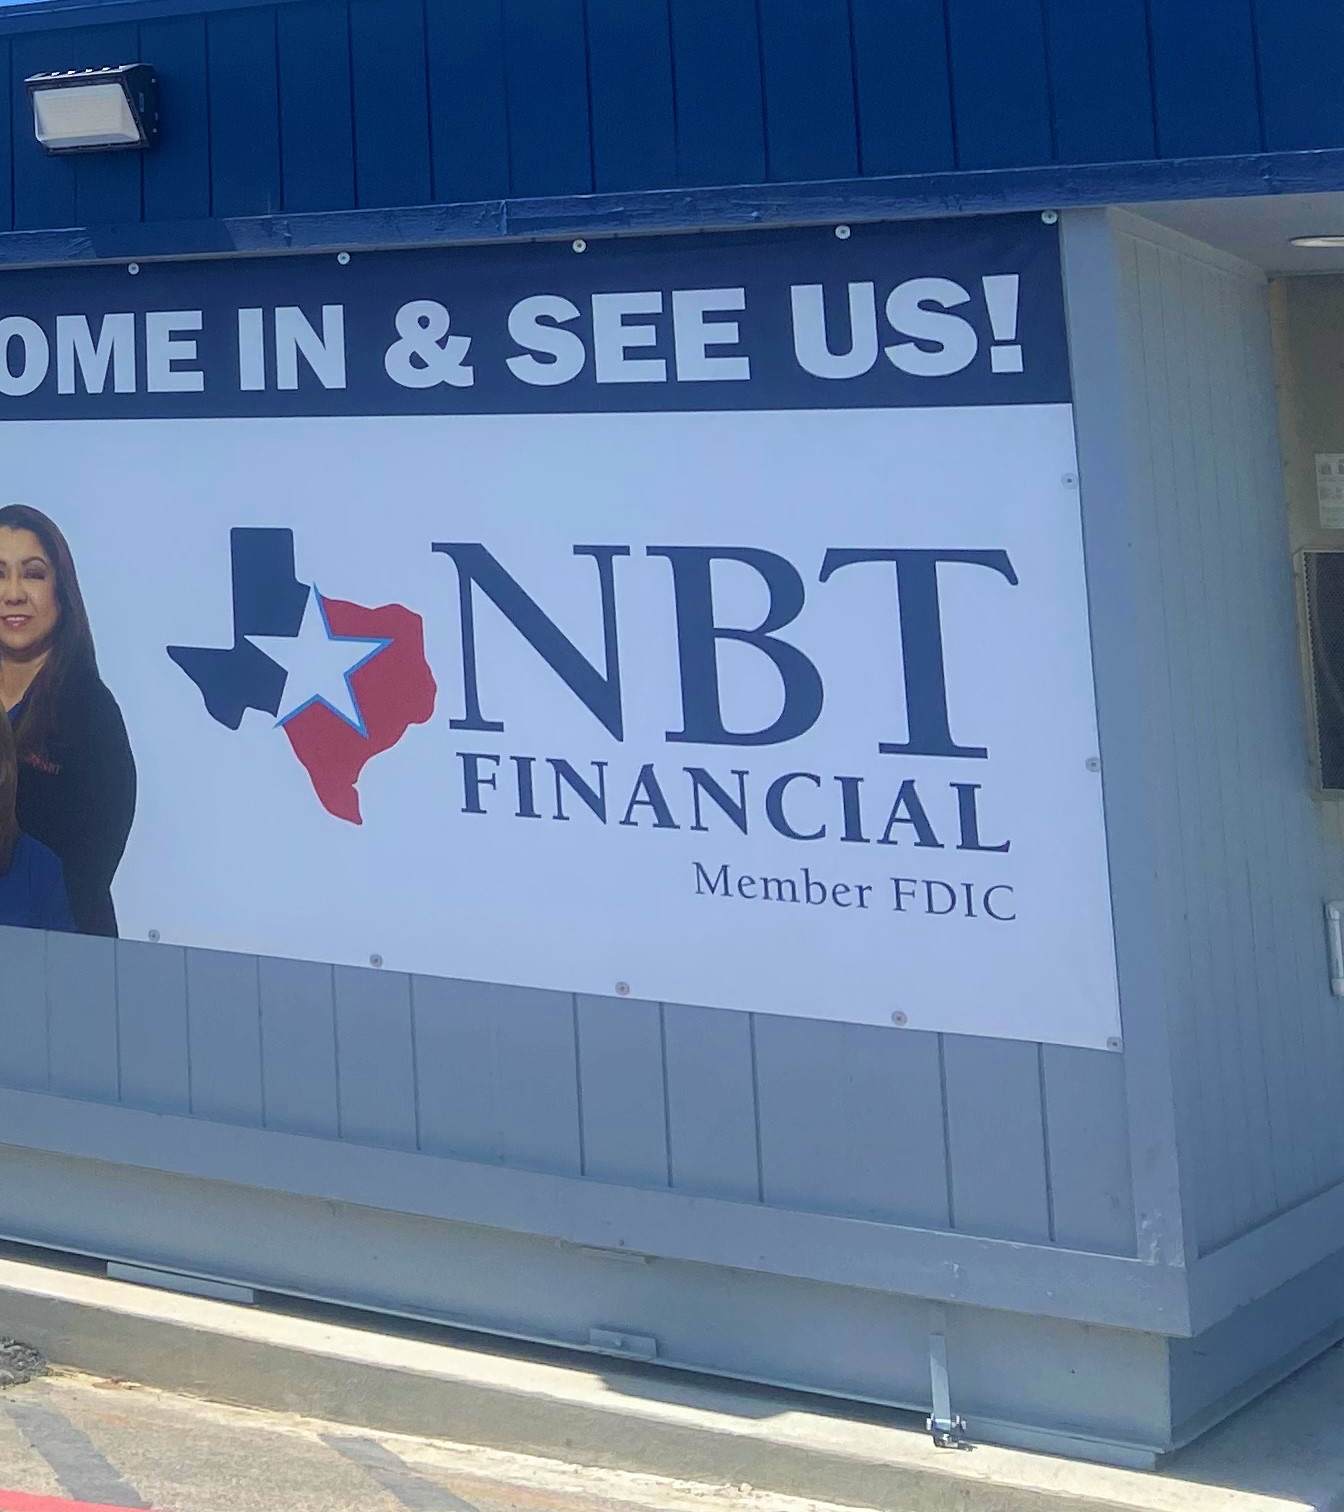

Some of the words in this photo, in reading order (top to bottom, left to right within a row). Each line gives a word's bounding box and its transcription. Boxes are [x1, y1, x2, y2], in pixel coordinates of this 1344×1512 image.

[238, 304, 347, 391] IN
[384, 299, 475, 389] &
[505, 287, 751, 386] SEE
[790, 274, 1024, 379] US!
[431, 541, 1019, 760] NBT
[456, 752, 1011, 854] FINANCIAL
[691, 861, 873, 911] Member
[890, 877, 1018, 922] FDIC
